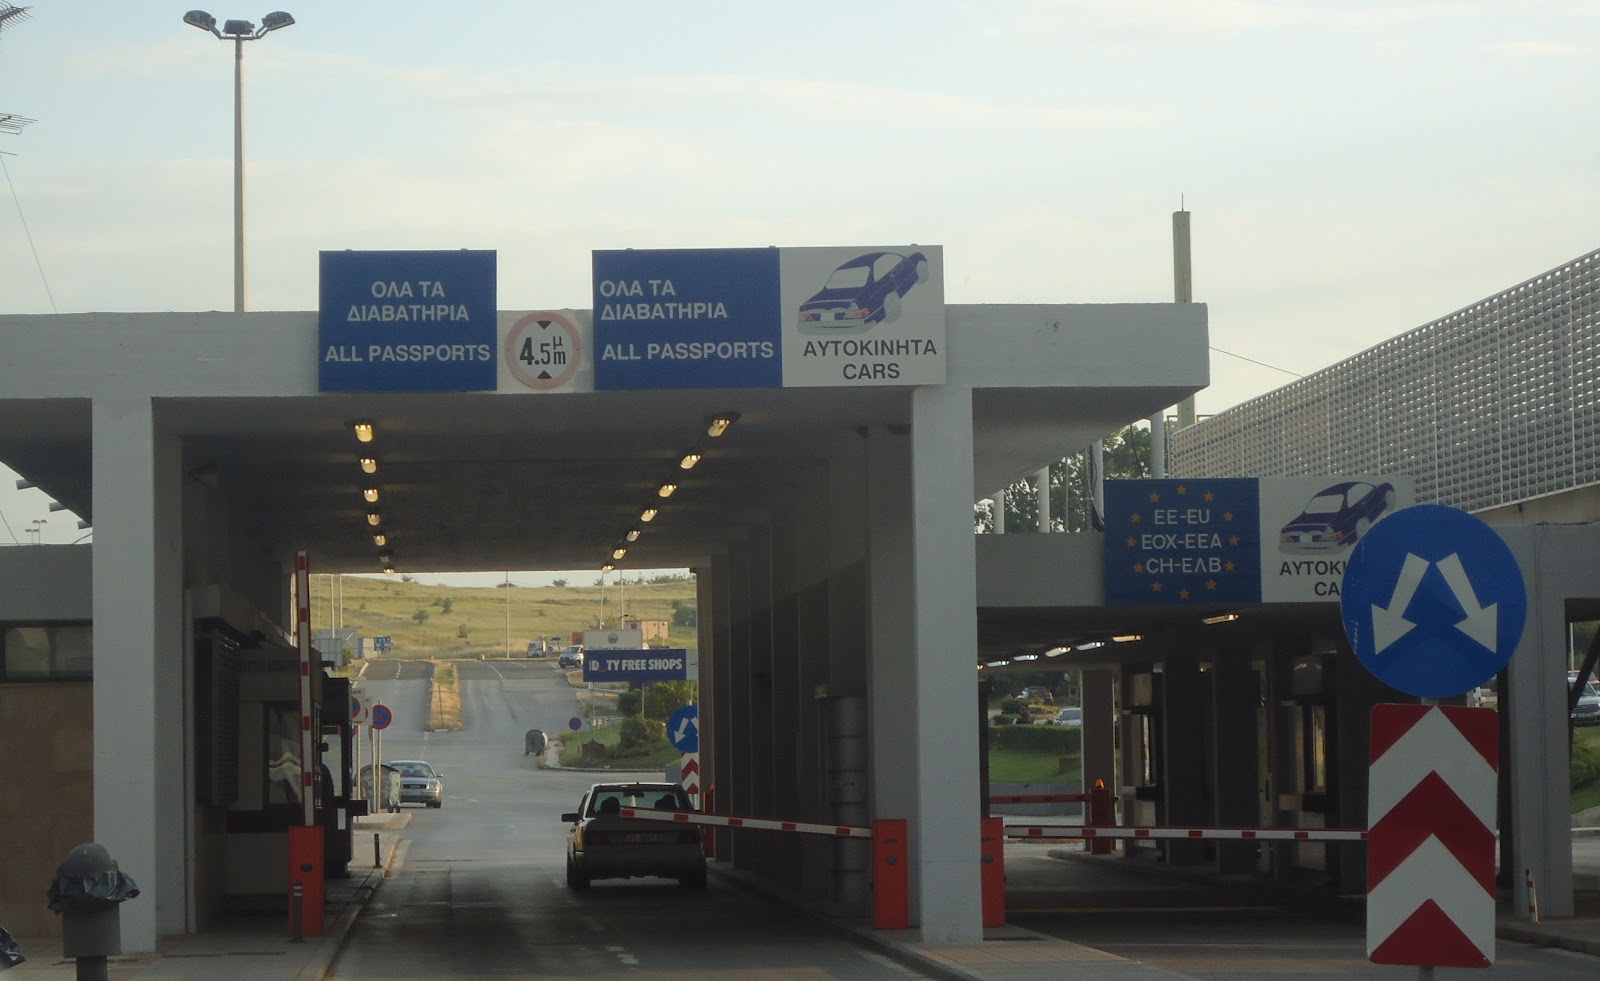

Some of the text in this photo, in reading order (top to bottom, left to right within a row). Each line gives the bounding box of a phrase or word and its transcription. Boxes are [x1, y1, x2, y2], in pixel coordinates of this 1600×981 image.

[371, 281, 445, 298] ΟΛΑ ΤΑ
[600, 280, 676, 298] ΟΛΑ ΤΑ
[347, 304, 470, 322] ΔΙΑΒΑΤΗΡΙΑ
[600, 302, 728, 321] ΔΙΑΒΑΤΗΡΙΑ
[324, 344, 491, 362] ALL PASSPORTS
[602, 341, 774, 361] ALL PASSPORTS
[803, 339, 937, 357] ΑΥΤΟΚΙΝΗΤΑ
[843, 363, 901, 381] CARS
[1279, 560, 1347, 577] ΑΥΤΟΚΙ
[1314, 581, 1341, 597] CA
[621, 659, 646, 671] FREE
[648, 658, 683, 671] SHOPS
